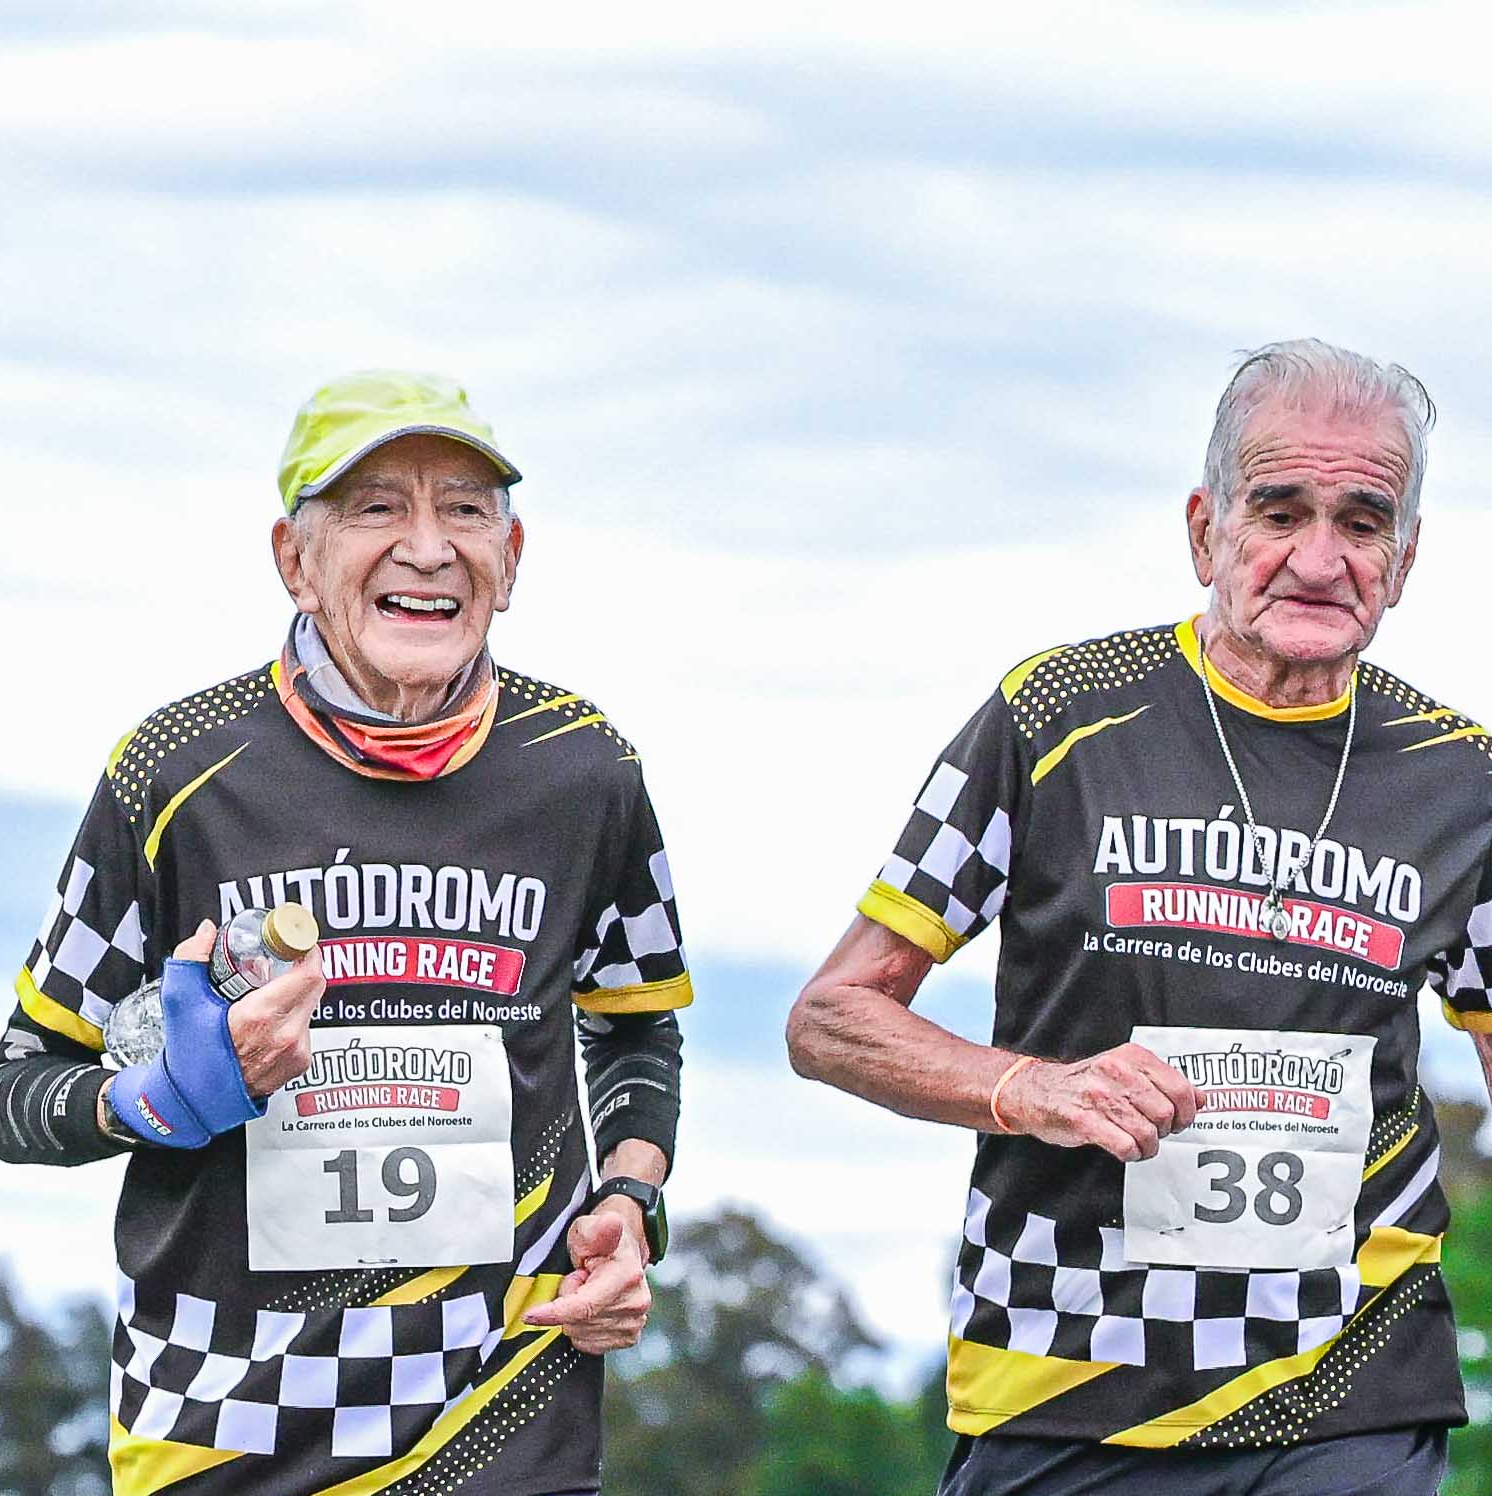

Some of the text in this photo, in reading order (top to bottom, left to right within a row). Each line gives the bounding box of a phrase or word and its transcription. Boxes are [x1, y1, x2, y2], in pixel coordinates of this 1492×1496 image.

[1093, 804, 1422, 923] AUTÓDROMO
[1289, 905, 1373, 956] RACE
[322, 942, 497, 987] NNING RACE
[1103, 933, 1173, 959] Carrera
[1178, 941, 1201, 963] de
[1206, 945, 1233, 968] los
[1237, 952, 1303, 978] Clubes
[1307, 960, 1338, 983] del
[1342, 966, 1407, 998] Noroeste
[311, 999, 542, 1020] de los Clubes del Noroeste
[314, 1086, 441, 1112] RUNNING RACE
[1200, 1091, 1314, 1115] UNNING RACE
[282, 1116, 473, 1132] La Carrera de los Clubes del Noroeste
[1216, 1119, 1229, 1130] de
[1232, 1119, 1247, 1130] los
[1249, 1119, 1282, 1132] Clubes
[1284, 1121, 1299, 1132] del
[1301, 1122, 1339, 1135] Noroeste
[323, 1147, 437, 1224] 19
[1194, 1149, 1305, 1226] 38
